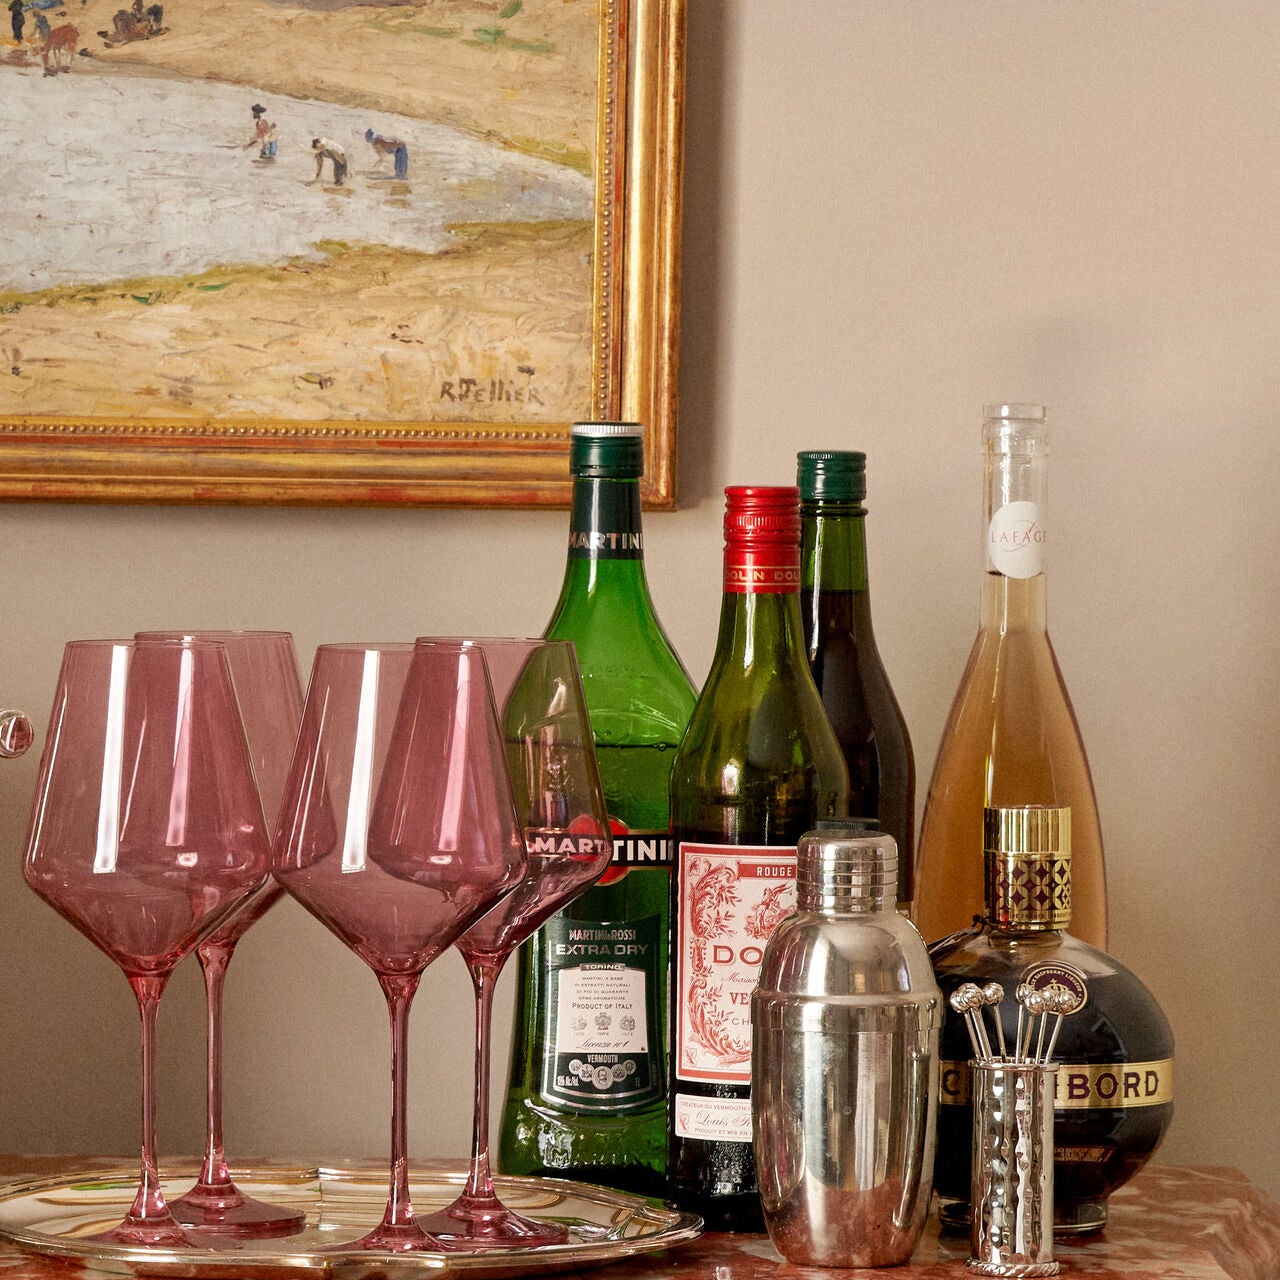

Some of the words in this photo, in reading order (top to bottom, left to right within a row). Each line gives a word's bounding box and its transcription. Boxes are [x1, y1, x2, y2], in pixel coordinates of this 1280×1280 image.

[756, 866, 793, 877] ROUGE
[555, 943, 611, 955] EXTRA
[614, 944, 649, 956] DRY
[571, 1002, 602, 1010] PRODUCT
[587, 1054, 619, 1063] VERMOUTH
